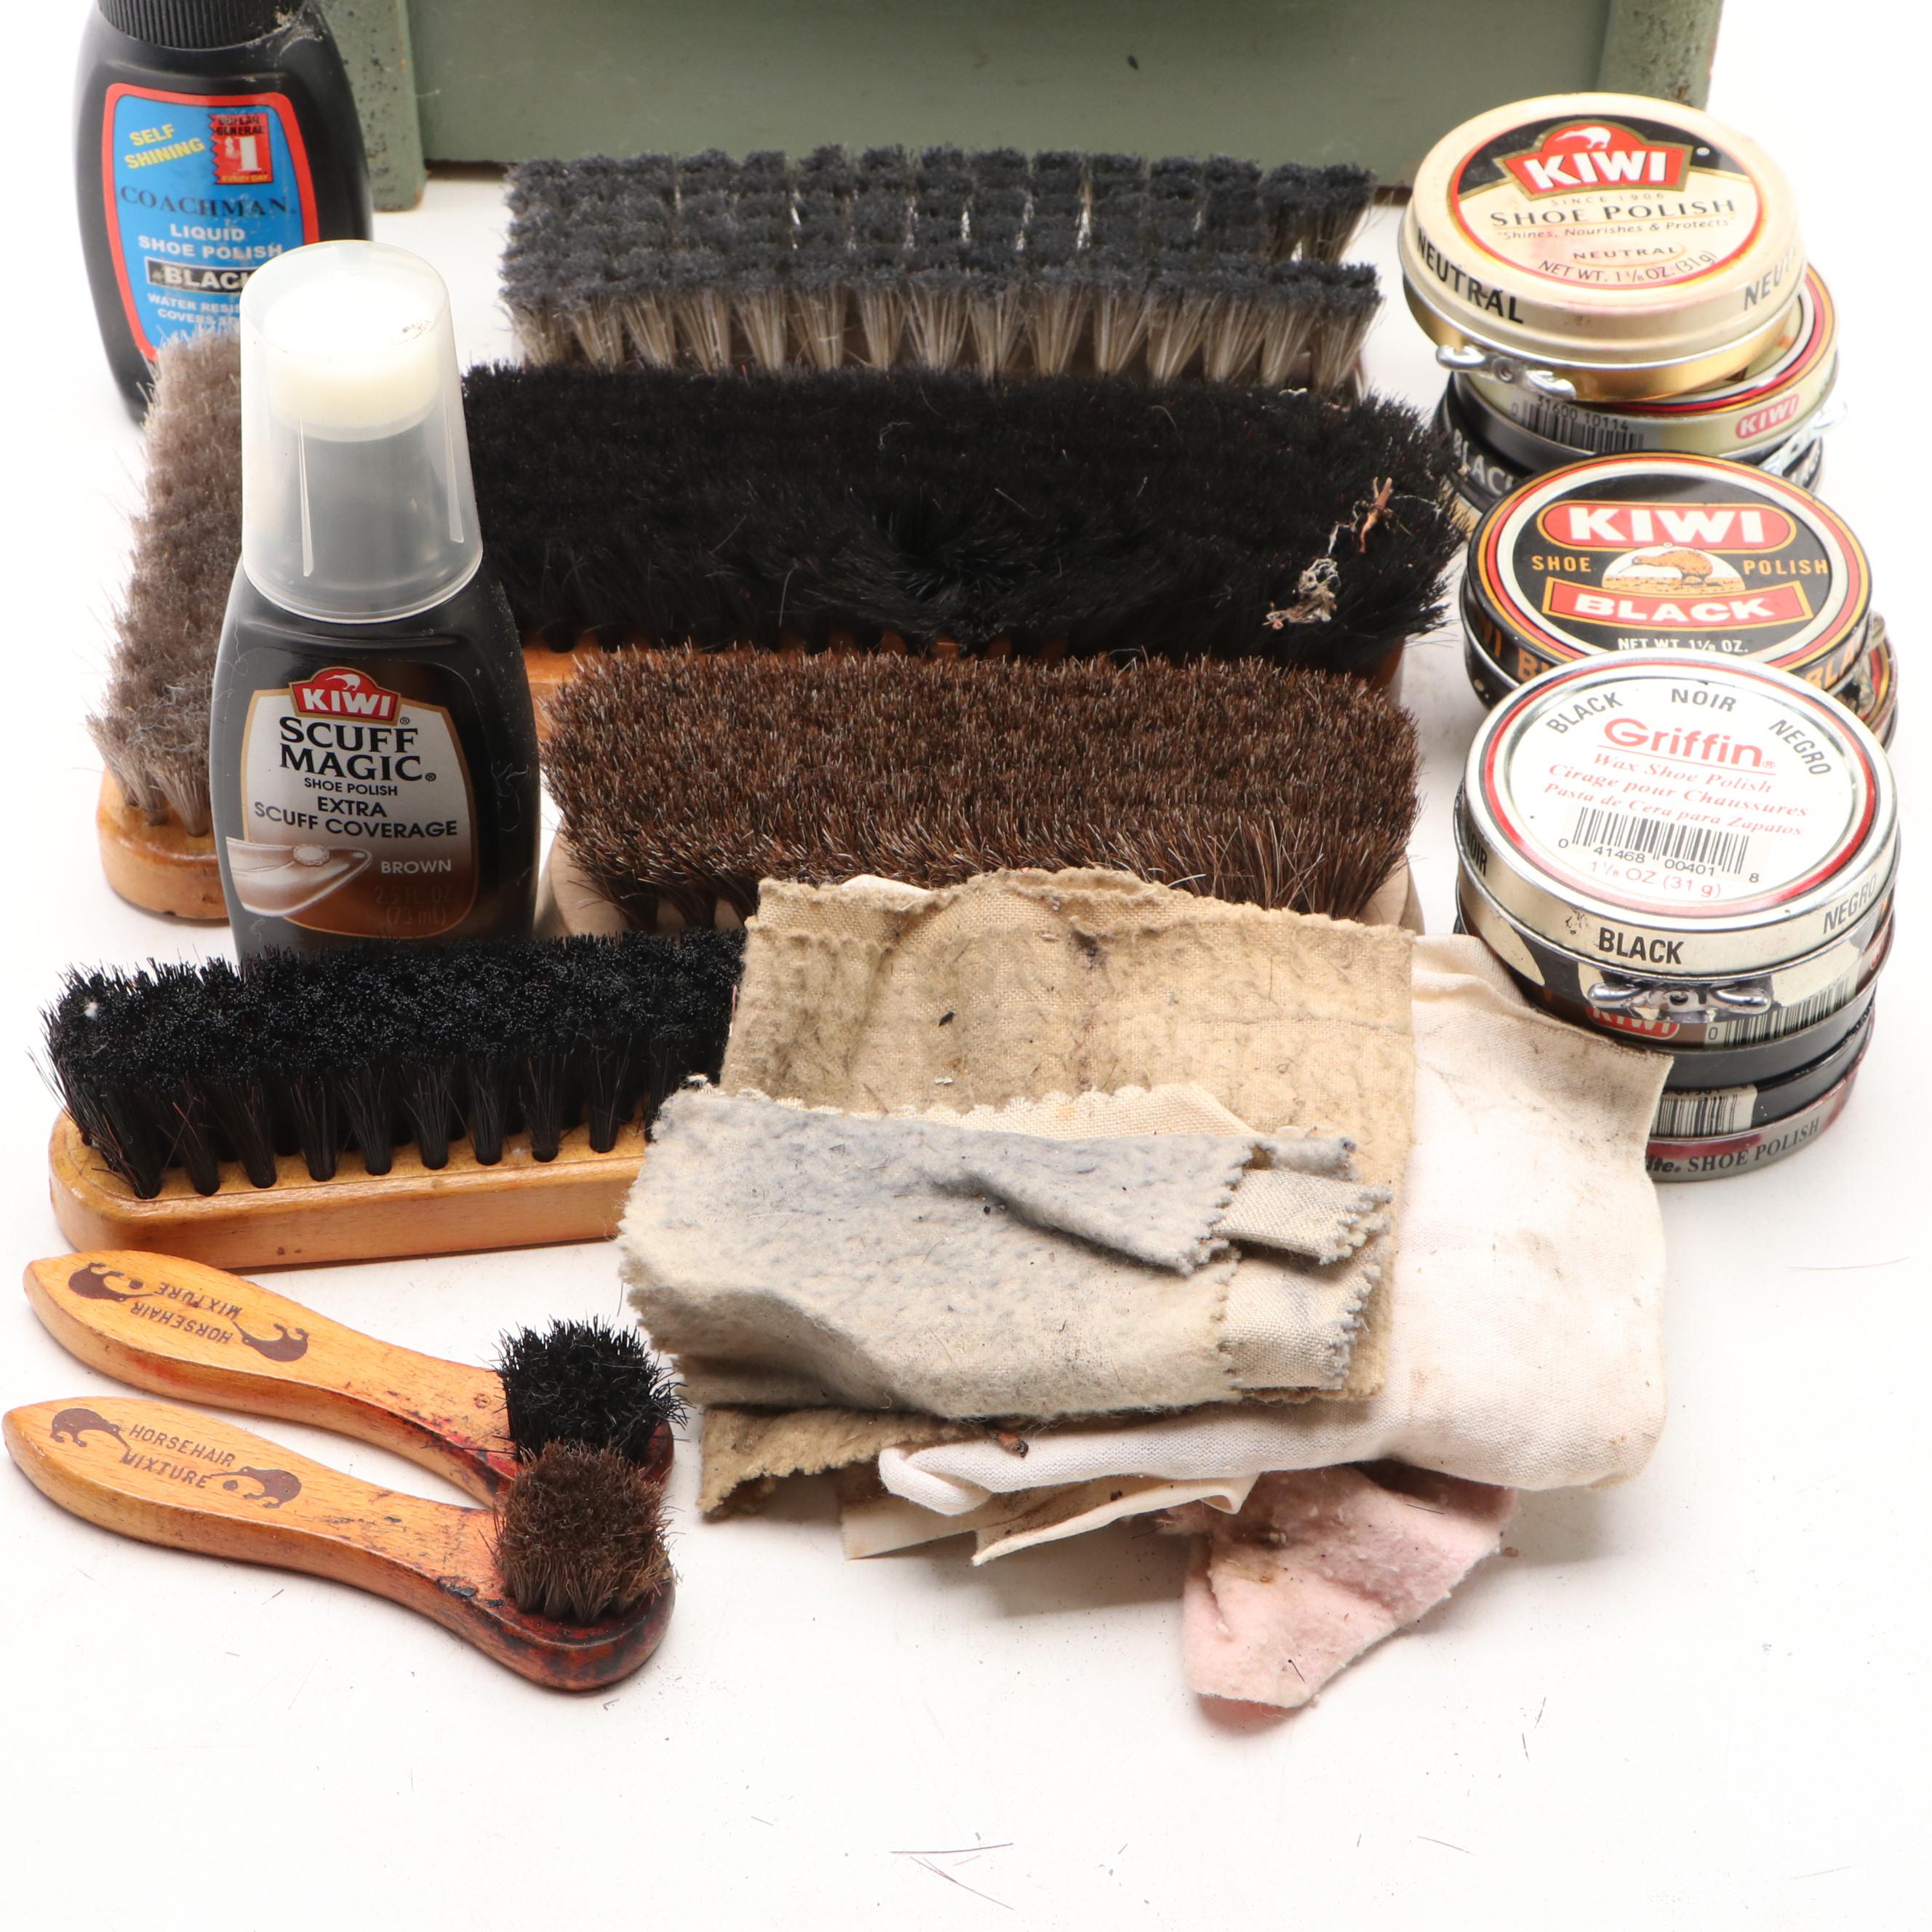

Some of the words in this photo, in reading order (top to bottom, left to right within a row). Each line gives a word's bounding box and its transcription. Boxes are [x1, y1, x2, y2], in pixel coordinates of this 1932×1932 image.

[124, 137, 206, 169] SHINING
[129, 123, 175, 147] SELF
[1525, 151, 1667, 190] KIWI
[1490, 209, 1590, 228] SHOE
[1602, 199, 1736, 220] POLISH
[1550, 195, 1606, 207] SINCE
[1618, 192, 1665, 202] 1906
[137, 234, 196, 257] SHOE
[201, 244, 283, 260] POLISH
[169, 223, 246, 242] LIQUID
[1565, 223, 1642, 236] Nourishes
[1648, 222, 1661, 231] &
[1538, 259, 1575, 277] NET
[1578, 268, 1608, 282] WT.
[1573, 246, 1679, 260] NEUTRAL
[1417, 228, 1524, 325] NEUTRAL
[147, 292, 197, 311] WATER
[1536, 394, 1578, 421] 31600
[1584, 412, 1630, 431] 10114
[1739, 395, 1799, 436] KIWI
[1568, 506, 1765, 544] KIWI
[1530, 555, 1592, 573] SHOE
[1743, 559, 1829, 576] POLISH
[1573, 594, 1776, 624] BLACK
[300, 687, 394, 717] KIWI
[1546, 691, 1624, 735] BLACK
[1670, 687, 1738, 713] NOIR
[278, 716, 419, 754] SCUFF
[1603, 717, 1763, 768] Griffin
[1768, 717, 1832, 777] NEGRO
[279, 743, 424, 783] MAGIC
[1594, 752, 1640, 772] Wax
[1644, 762, 1699, 783] Shoe
[1705, 773, 1773, 794] Polish
[303, 775, 343, 794] SHOE
[346, 782, 399, 797] POLISH
[1548, 764, 1619, 789] Cirage
[1622, 781, 1677, 798] pour
[1683, 789, 1809, 818] Chaussures
[254, 801, 319, 830] SCUFF
[324, 817, 458, 839] COVERAGE
[316, 796, 388, 818] EXTRA
[1543, 782, 1595, 803] Pasta
[1600, 795, 1622, 807] de
[1628, 799, 1673, 818] Cera
[1675, 810, 1722, 825] para
[1727, 815, 1804, 837] Zapatos
[380, 858, 452, 874] BROWN
[1557, 837, 1570, 850] 0
[1593, 845, 1646, 864] 41468
[1663, 858, 1717, 877] 00401
[1748, 872, 1760, 885] 8
[1625, 866, 1658, 885] OZ
[1823, 872, 1877, 935] NEGRO
[1600, 927, 1685, 966] BLACK
[1708, 1026, 1719, 1040] 0
[1687, 1149, 1749, 1173] SHOE
[1753, 1117, 1822, 1162] POLISH
[153, 1281, 244, 1320] MIXTURE
[129, 1301, 234, 1345] HORSEHAIR
[129, 1424, 237, 1467] HORSEHAIR
[121, 1450, 209, 1490] MIXTURE
